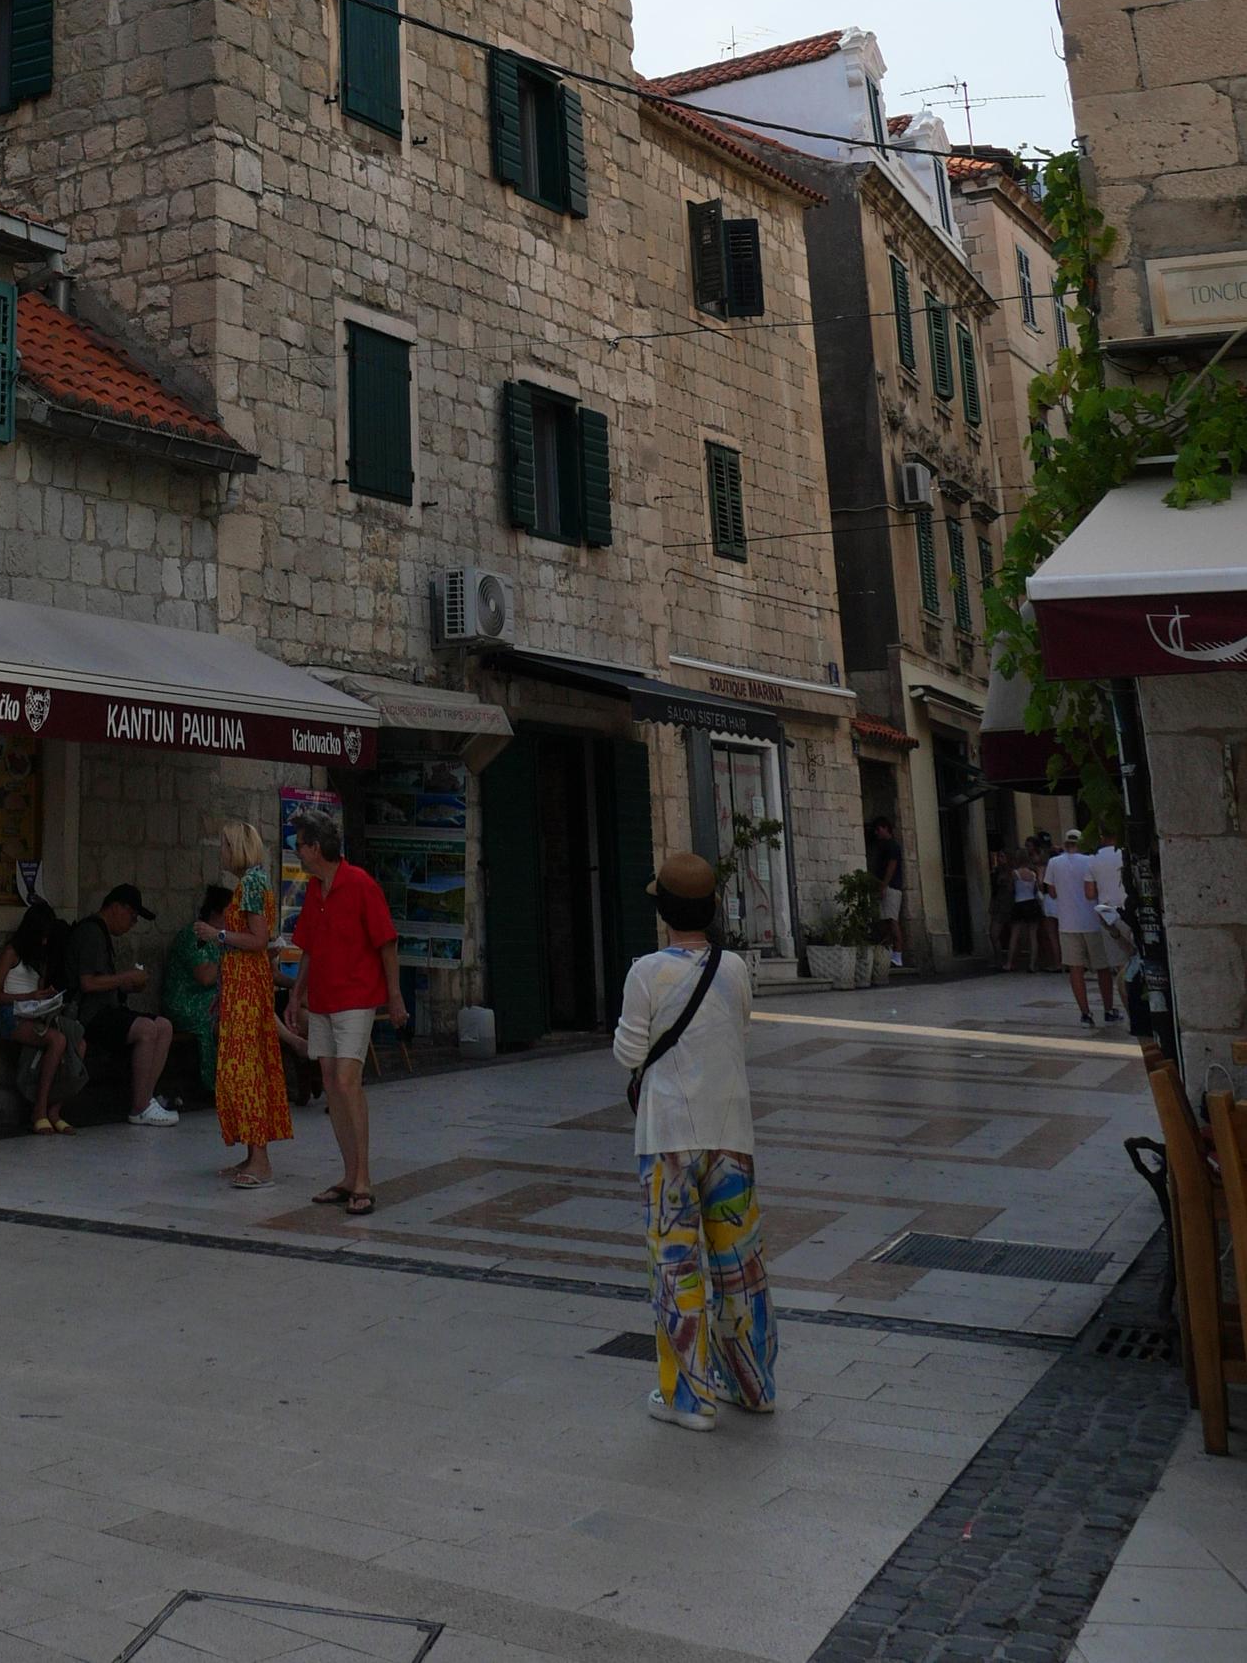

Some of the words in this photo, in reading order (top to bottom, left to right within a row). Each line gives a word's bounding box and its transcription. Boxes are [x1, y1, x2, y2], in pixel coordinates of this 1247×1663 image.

[709, 677, 747, 697] BOUTIQUE
[748, 681, 785, 704] MARINA
[107, 703, 175, 743] KANTUN
[182, 712, 246, 751] PAULINA
[428, 707, 442, 719] DAY
[443, 709, 464, 721] TRIPS
[667, 705, 696, 723] SALON
[697, 710, 727, 728] SISTER
[728, 715, 747, 730] HAIR
[292, 728, 341, 755] Karlovačko
